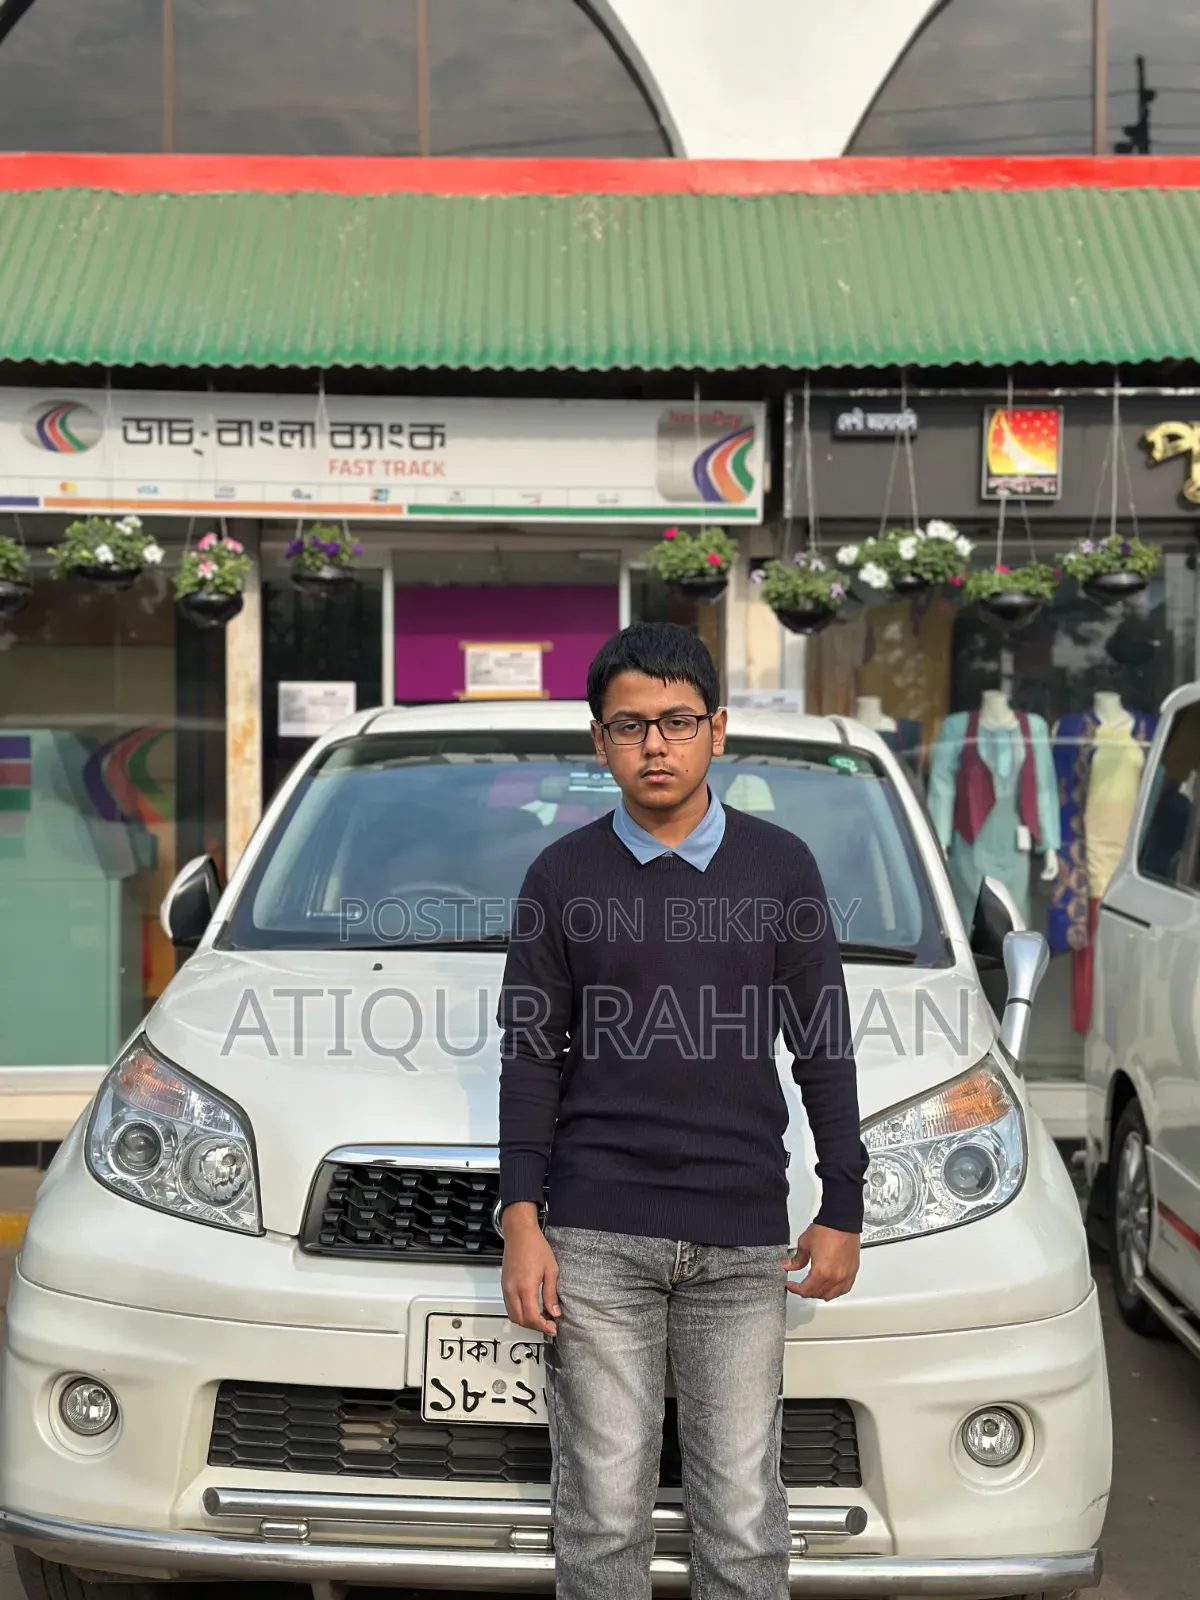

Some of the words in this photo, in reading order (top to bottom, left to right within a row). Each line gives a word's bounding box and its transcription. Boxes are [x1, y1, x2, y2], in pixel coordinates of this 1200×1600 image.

[329, 421, 447, 450] ব্যাংক
[329, 458, 375, 476] FAST
[383, 459, 446, 478] TRACK
[438, 1335, 501, 1363] ঢাকা
[509, 1341, 546, 1365] মে
[429, 1377, 548, 1415] ১৮-২
